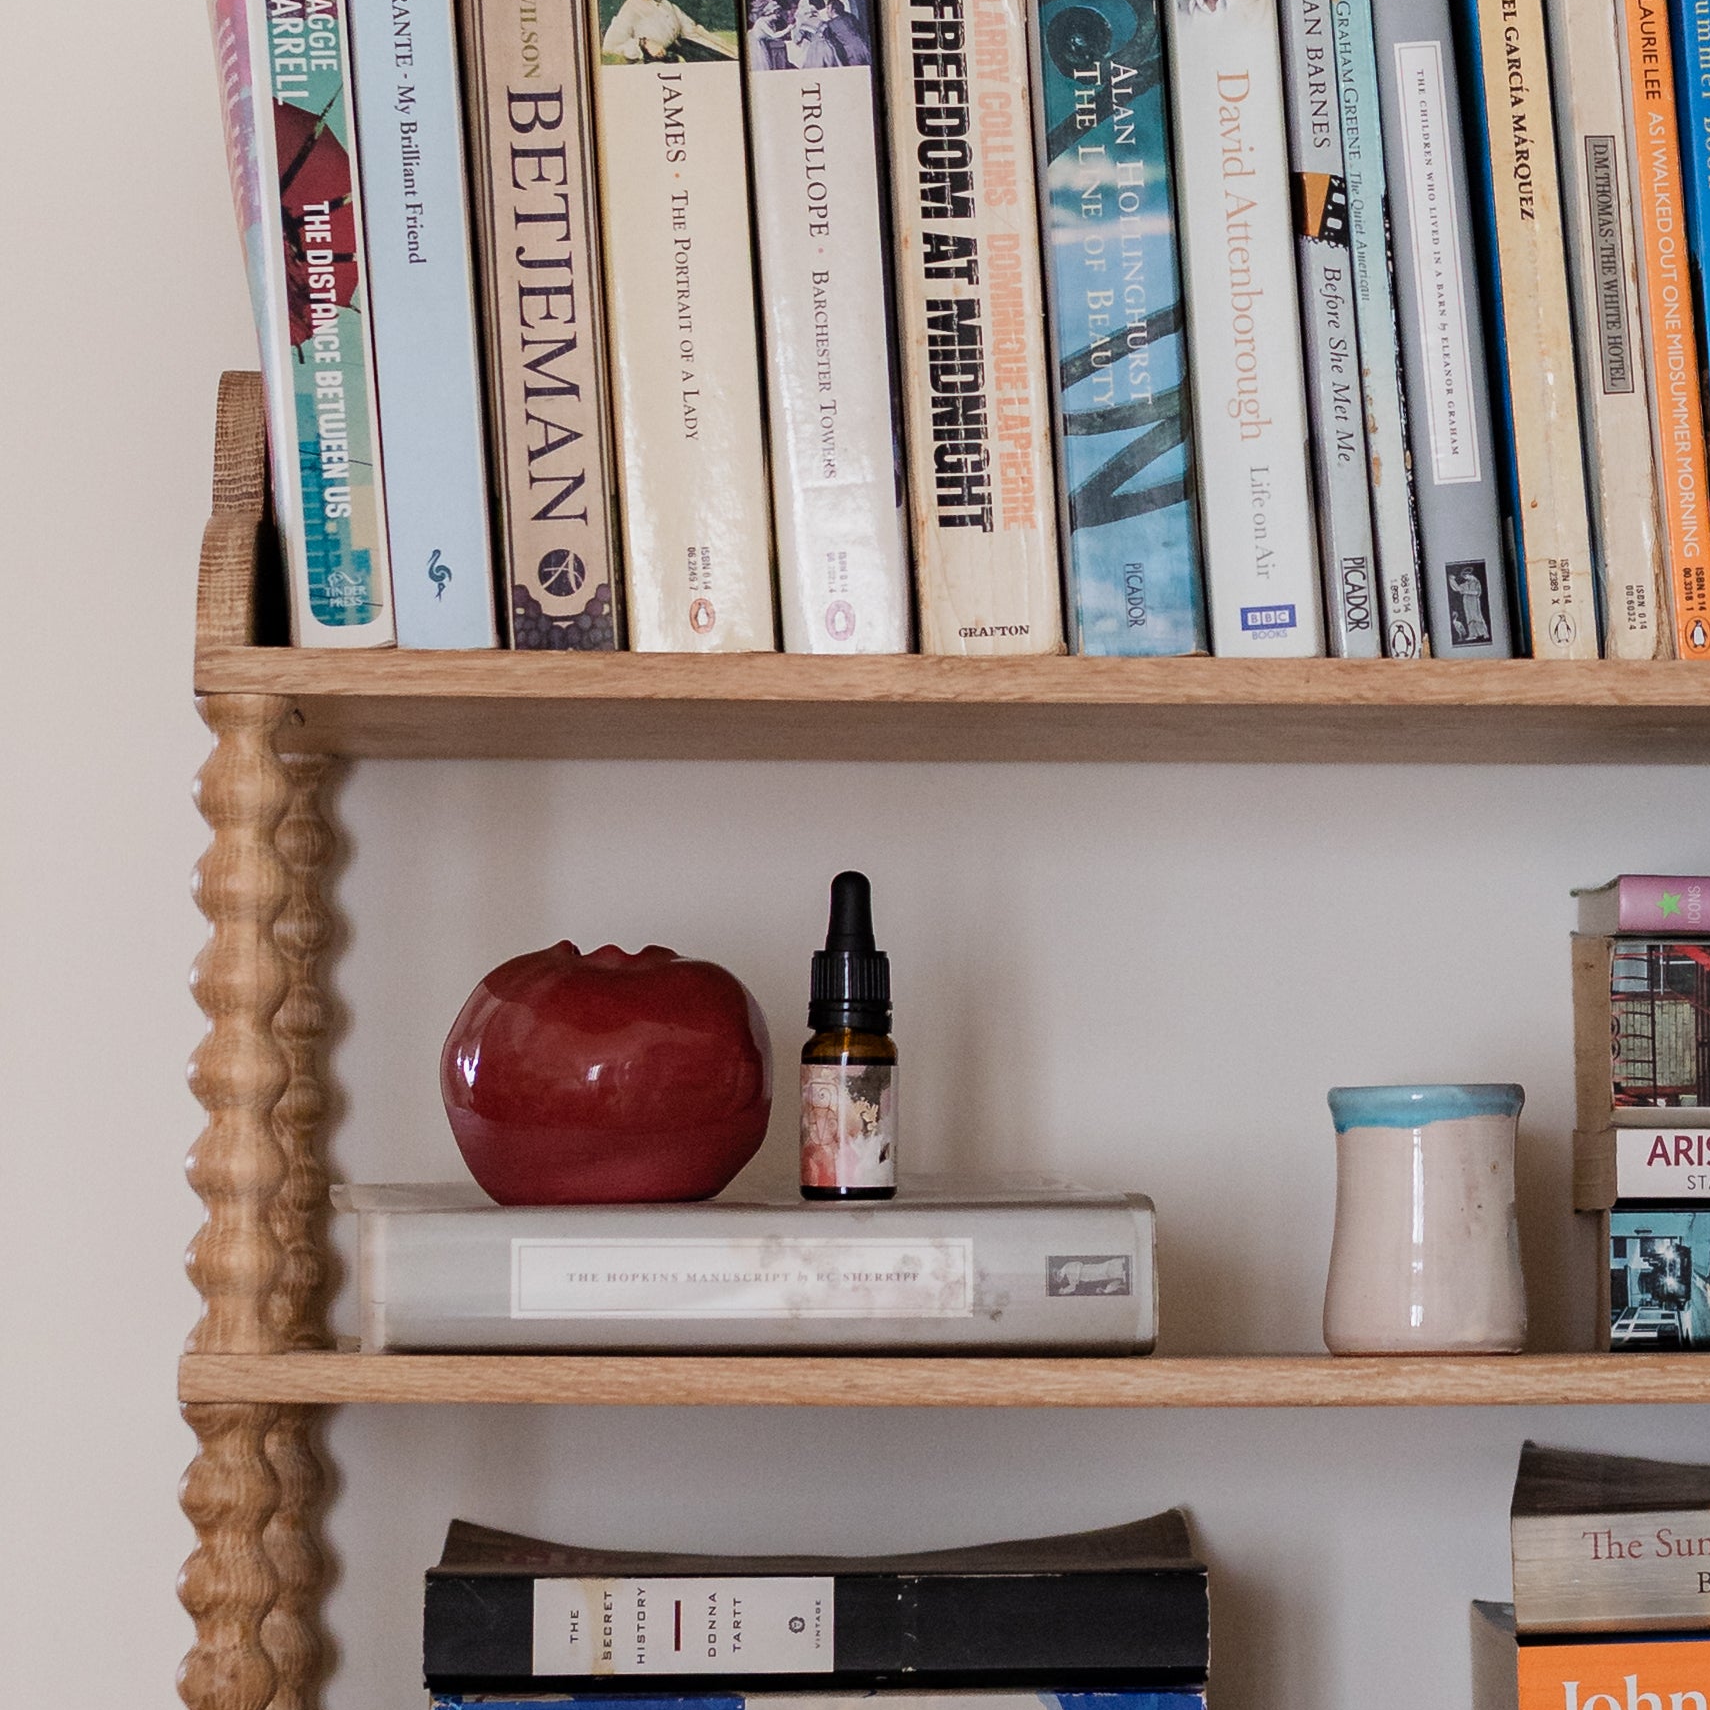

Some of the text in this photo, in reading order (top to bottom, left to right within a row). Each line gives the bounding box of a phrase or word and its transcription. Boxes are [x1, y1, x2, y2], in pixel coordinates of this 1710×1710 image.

[1306, 46, 1331, 149] BARNES
[1643, 69, 1661, 100] LEE
[399, 122, 423, 198] Brilliant
[1334, 0, 1370, 301] GRAHAM GREENE Quiet American
[405, 203, 427, 264] Friend
[657, 72, 700, 442] JAMES THE PORTRAIT LADY
[923, 232, 979, 286] AT
[1073, 62, 1114, 407] THE LINE BEAUTY
[1110, 61, 1153, 404] ALAN HOLLINGHURST
[1657, 236, 1678, 282] OUT
[306, 249, 341, 364] DISTANCE
[507, 85, 588, 526] BETJEMAN
[801, 83, 837, 480] TROLLOPE BARCHESTER TOWERS
[1217, 69, 1272, 508] David Attenborough Life
[1662, 288, 1681, 330] ONE
[1328, 337, 1348, 373] She
[1665, 334, 1690, 453] MIDSUMMER
[926, 298, 994, 533] MIDNIGHT
[1332, 382, 1351, 422] Met
[1336, 430, 1355, 462] Me
[1677, 456, 1700, 558] MORNING
[958, 624, 1030, 639] GRAFTON
[1252, 629, 1288, 640] BOOKS
[636, 1587, 647, 1665] HISTORY
[708, 1592, 717, 1658] DONNA
[732, 1597, 742, 1653] TARTT
